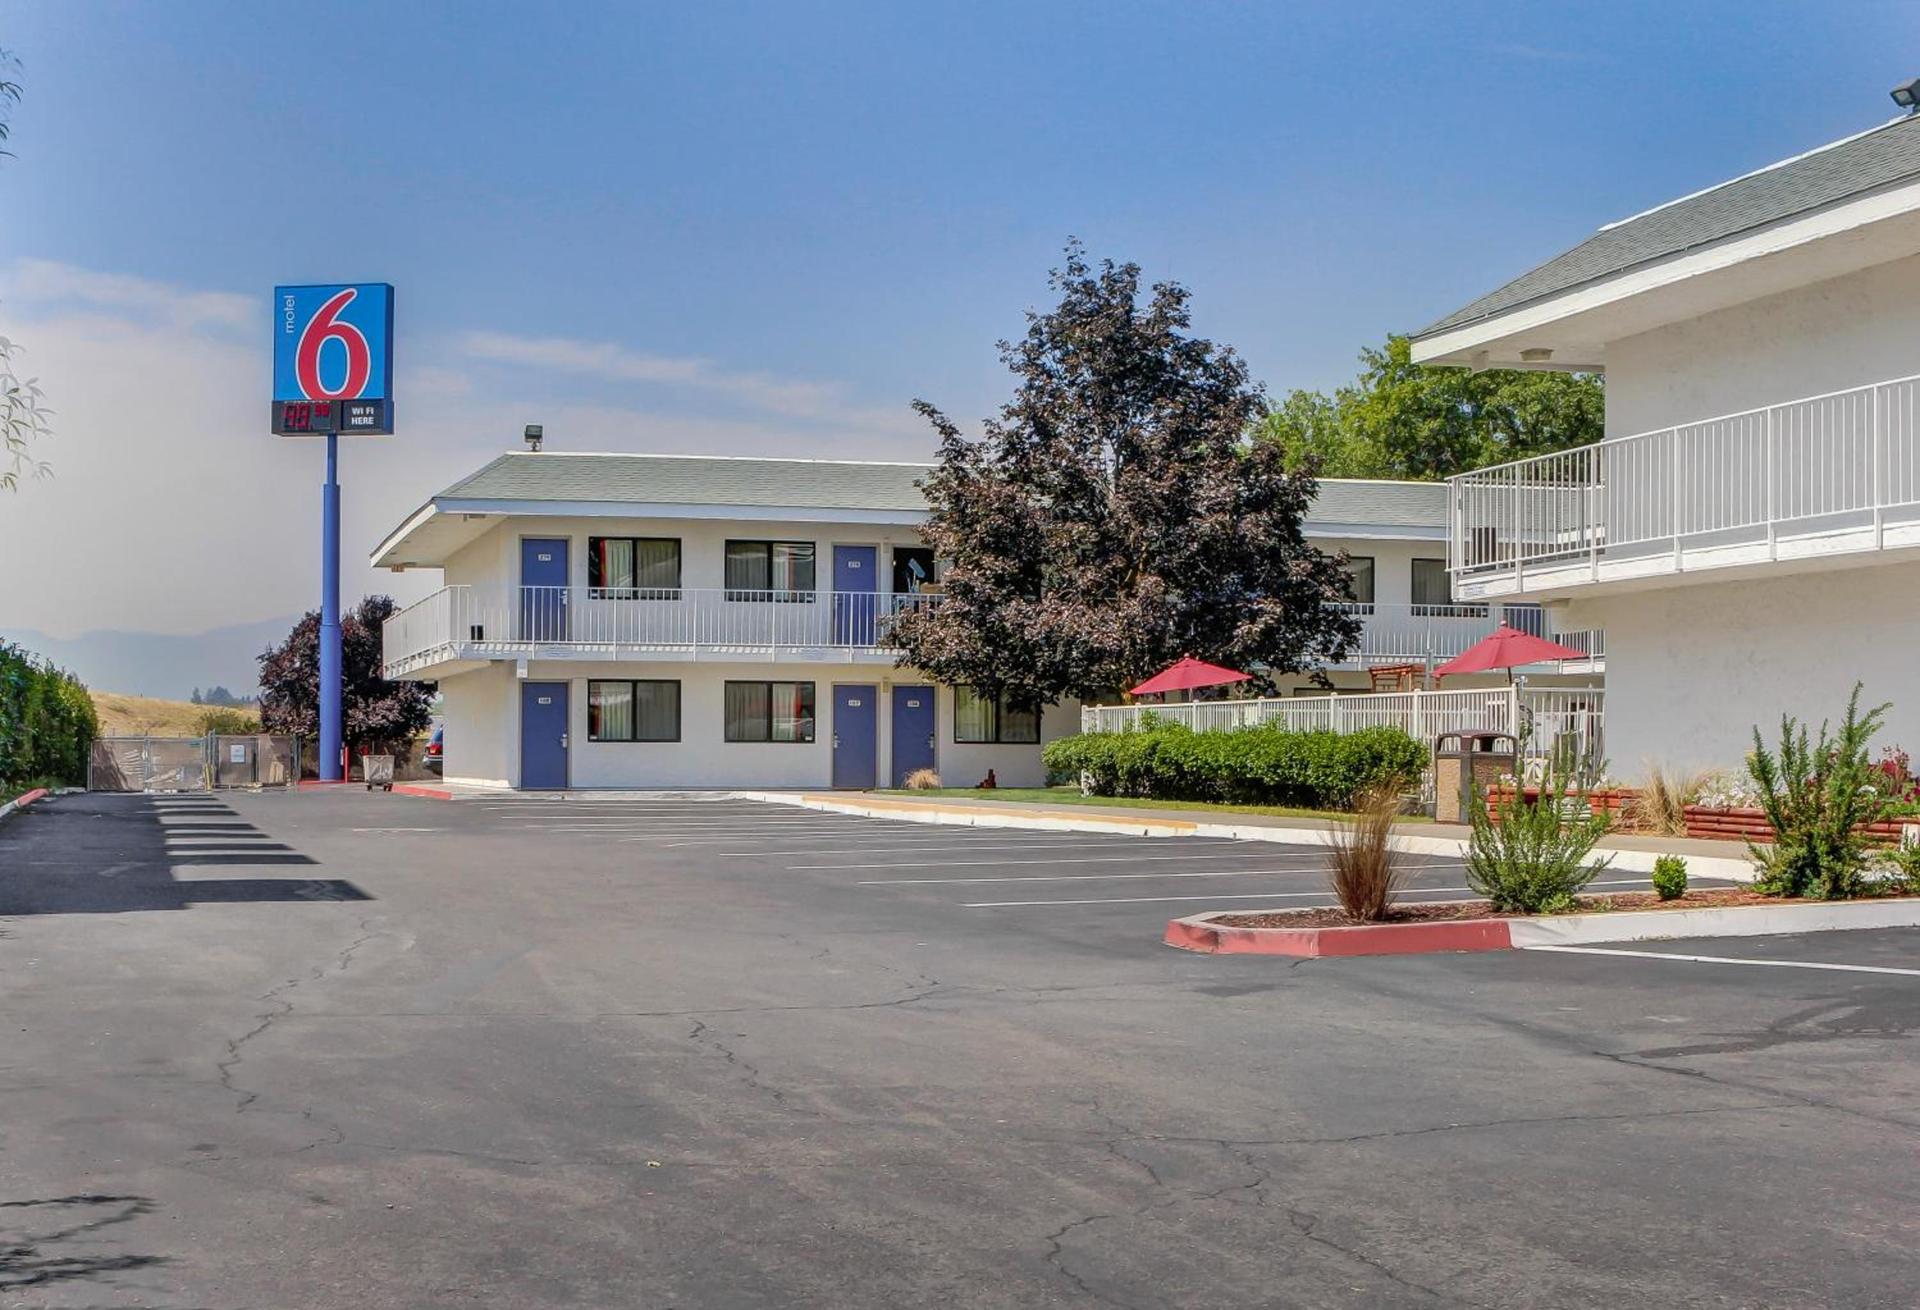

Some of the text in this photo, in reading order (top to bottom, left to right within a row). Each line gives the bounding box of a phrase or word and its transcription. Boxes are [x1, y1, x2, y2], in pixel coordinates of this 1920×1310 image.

[283, 295, 295, 333] motel
[295, 288, 371, 400] 6
[351, 406, 375, 415] WI FI
[351, 416, 375, 425] HERE
